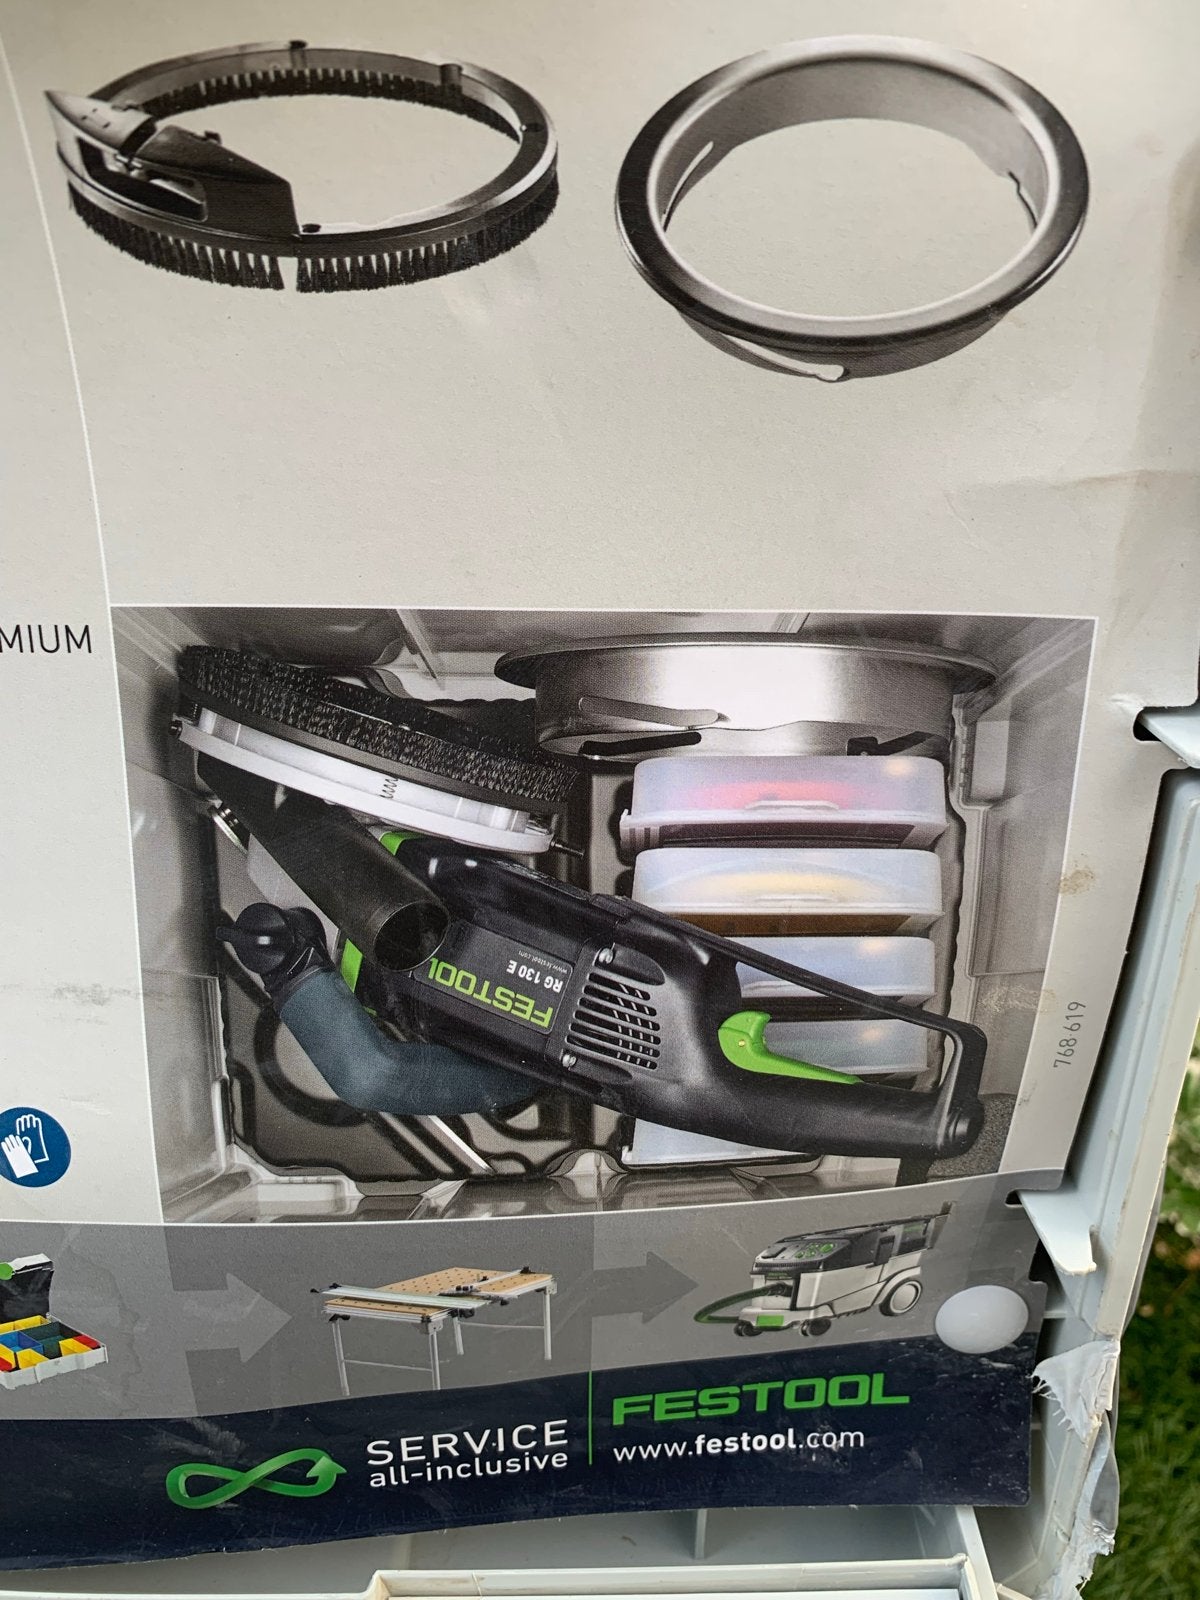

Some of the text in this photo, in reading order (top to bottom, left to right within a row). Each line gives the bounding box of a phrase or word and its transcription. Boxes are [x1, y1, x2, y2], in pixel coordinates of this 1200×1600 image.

[428, 957, 554, 1029] FESTOOL
[506, 959, 564, 993] RG 130 E
[611, 1372, 911, 1427] FESTOOL
[365, 1419, 569, 1466] SERVICE
[612, 1427, 866, 1463] www.festool.com
[368, 1450, 569, 1489] all-inclusive
